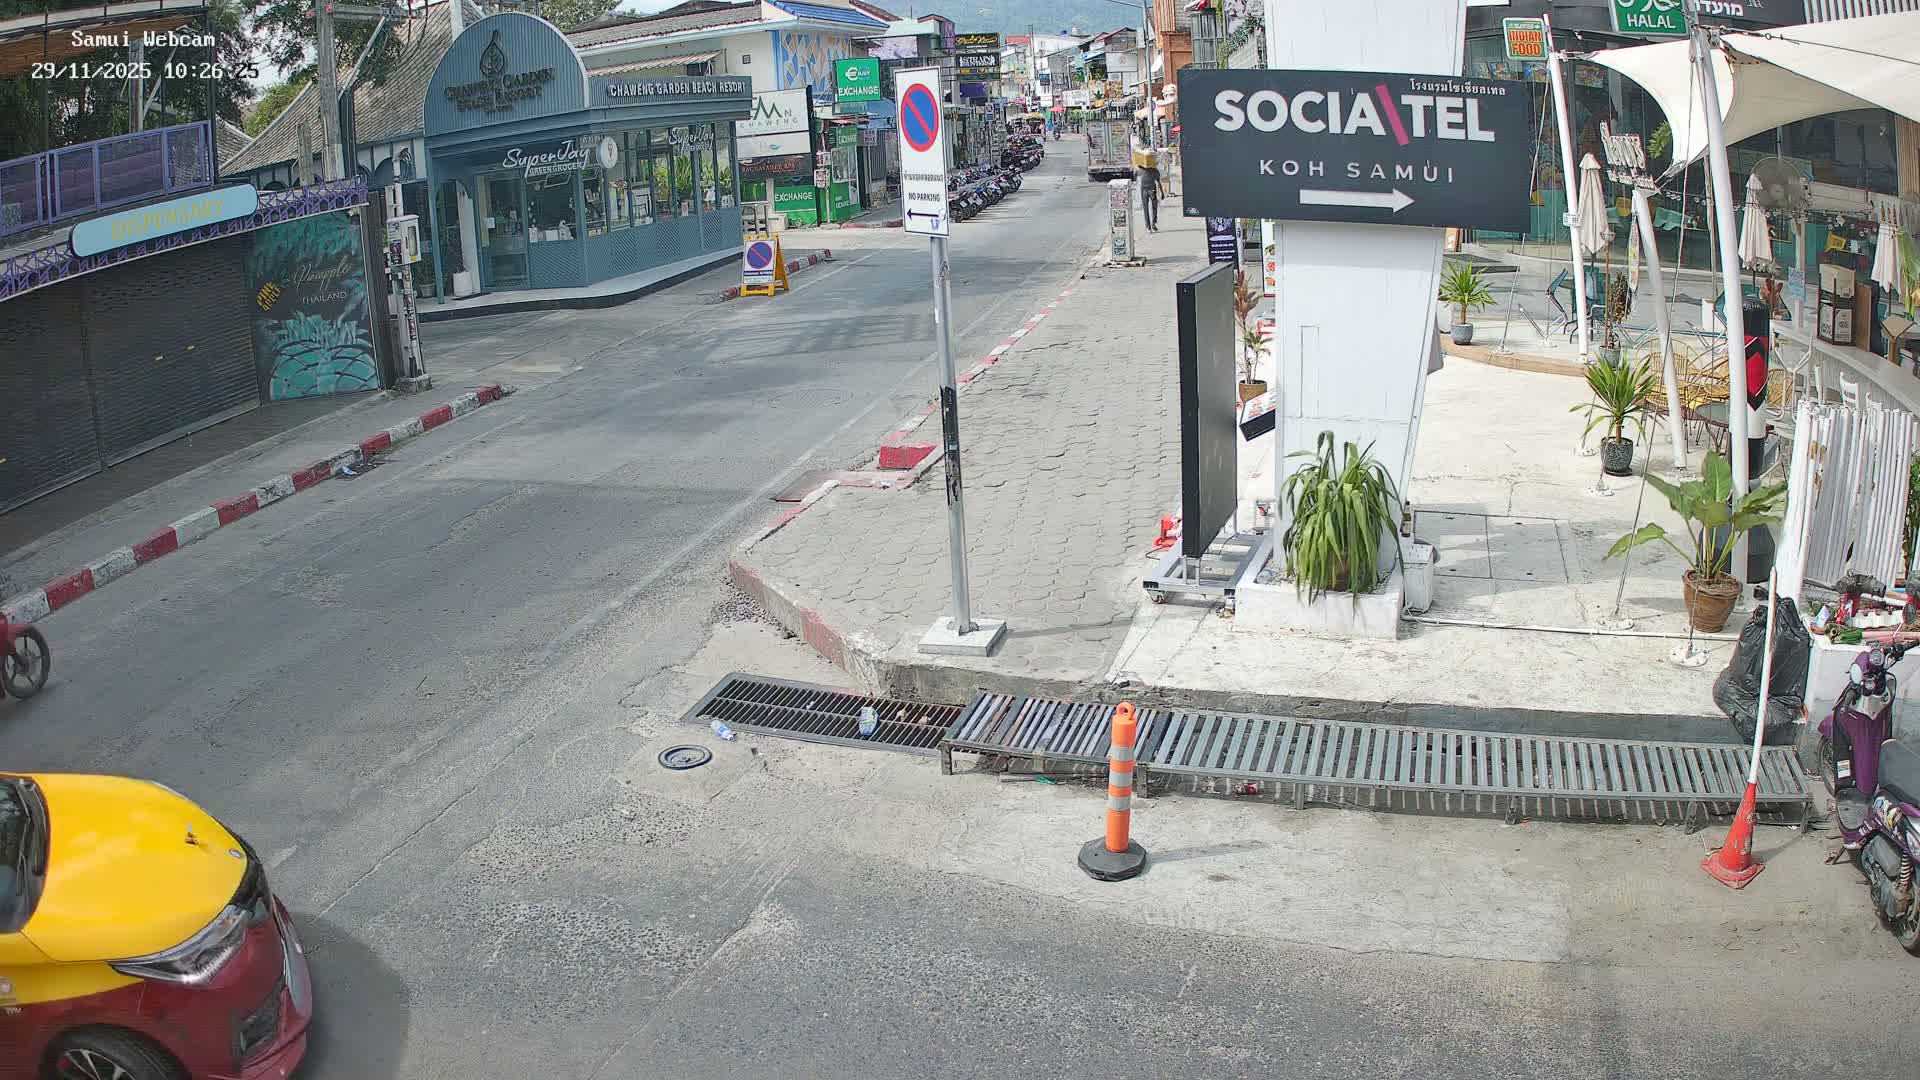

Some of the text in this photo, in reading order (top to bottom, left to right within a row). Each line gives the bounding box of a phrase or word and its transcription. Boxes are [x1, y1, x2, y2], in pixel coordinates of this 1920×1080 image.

[1627, 13, 1676, 29] HALAL
[1508, 30, 1542, 42] INDIAN
[1511, 42, 1541, 56] FOOD
[610, 80, 746, 97] CHAWENG GARDEN BEACH RESORT
[838, 86, 879, 97] EXCHANGE
[740, 117, 799, 129] CHAWENG
[668, 124, 714, 156] SuperJay
[502, 139, 591, 178] SuperJay
[1259, 158, 1454, 184] KOH SAMUI
[774, 191, 813, 202] EXCHANGE
[908, 192, 941, 202] NO PARKING
[112, 193, 225, 241] DISPENSARY
[302, 291, 347, 305] THAILAND
